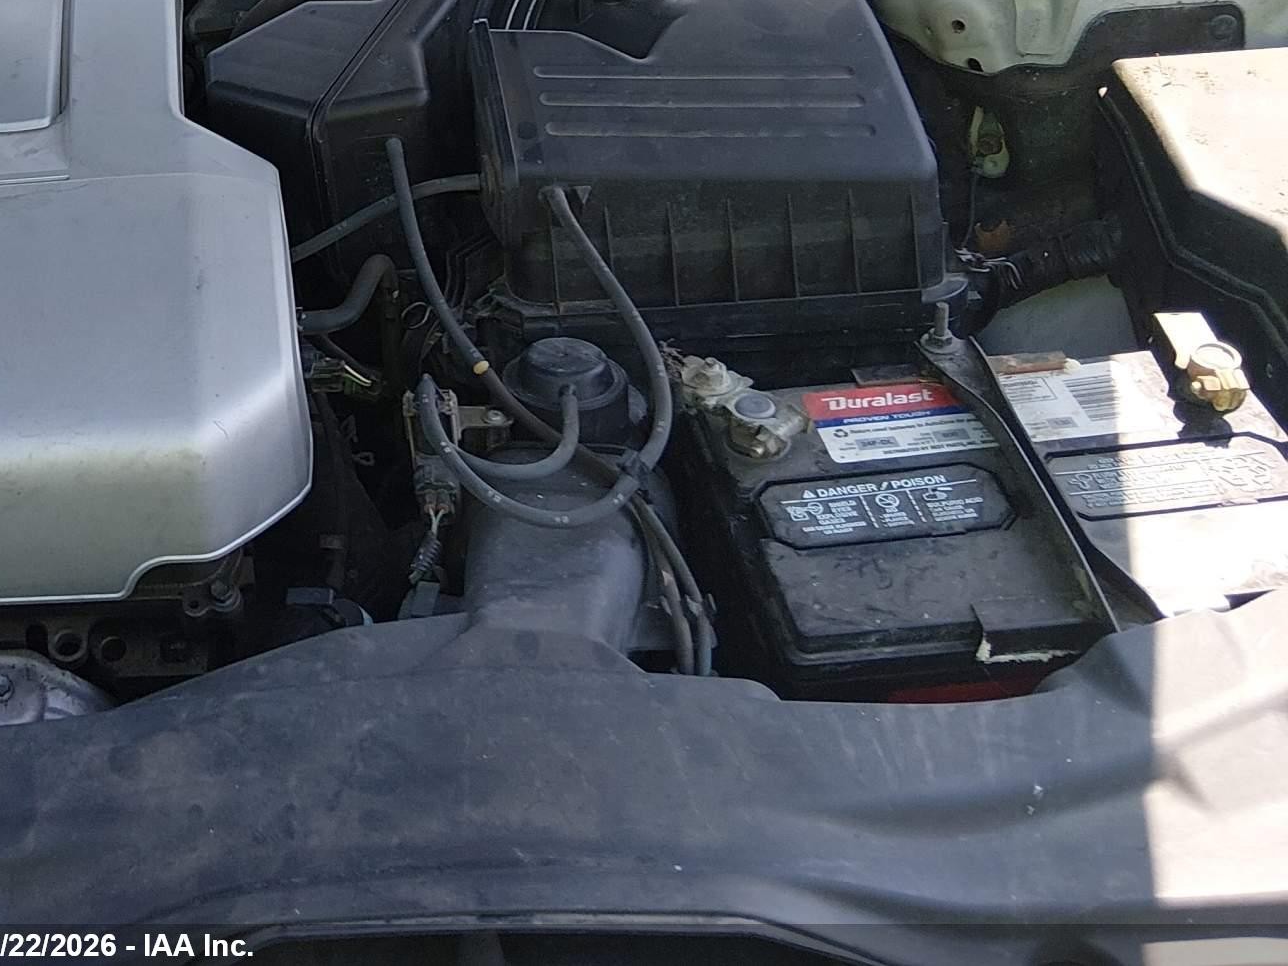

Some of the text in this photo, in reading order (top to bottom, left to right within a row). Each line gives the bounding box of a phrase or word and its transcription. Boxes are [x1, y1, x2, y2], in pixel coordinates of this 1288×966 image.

[820, 388, 935, 411] Duralast
[892, 410, 931, 419] TOUGH
[816, 483, 878, 498] DANGER
[891, 474, 947, 489] POISON
